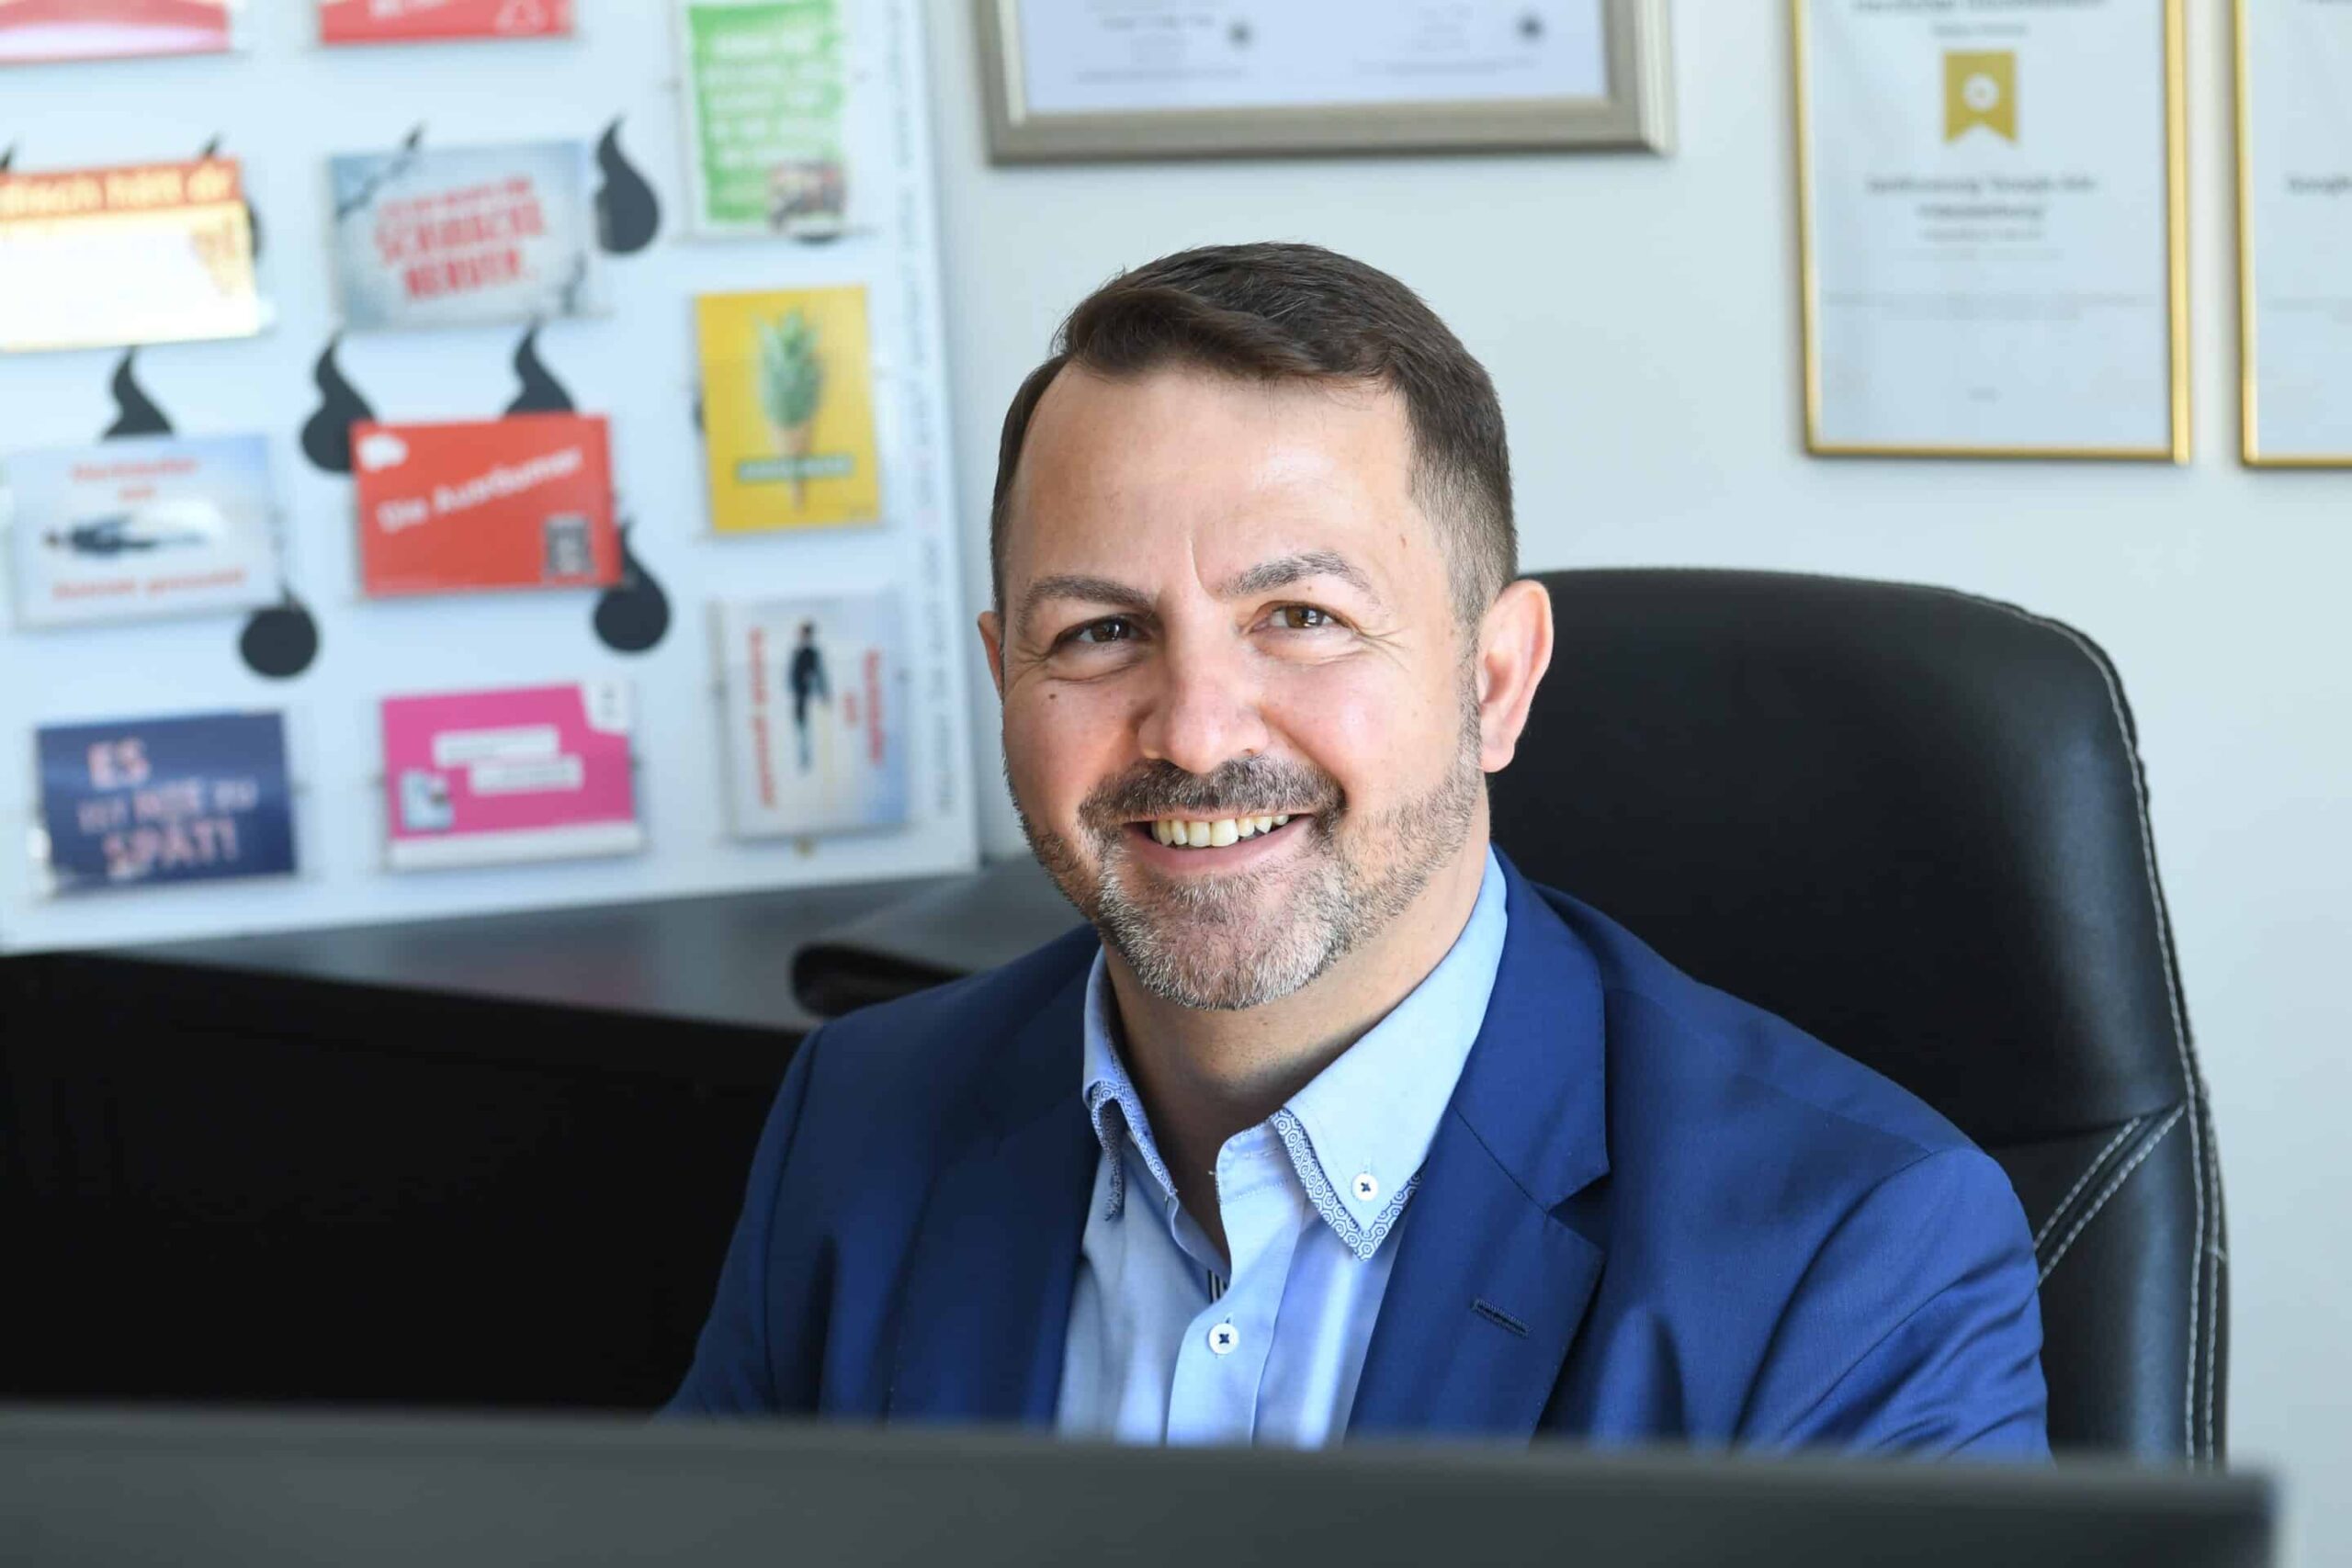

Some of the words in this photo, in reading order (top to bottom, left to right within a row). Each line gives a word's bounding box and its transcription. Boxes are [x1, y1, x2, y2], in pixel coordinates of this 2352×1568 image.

[378, 499, 427, 532] Die
[89, 738, 149, 786] ES
[103, 816, 235, 879] SPÄT!
